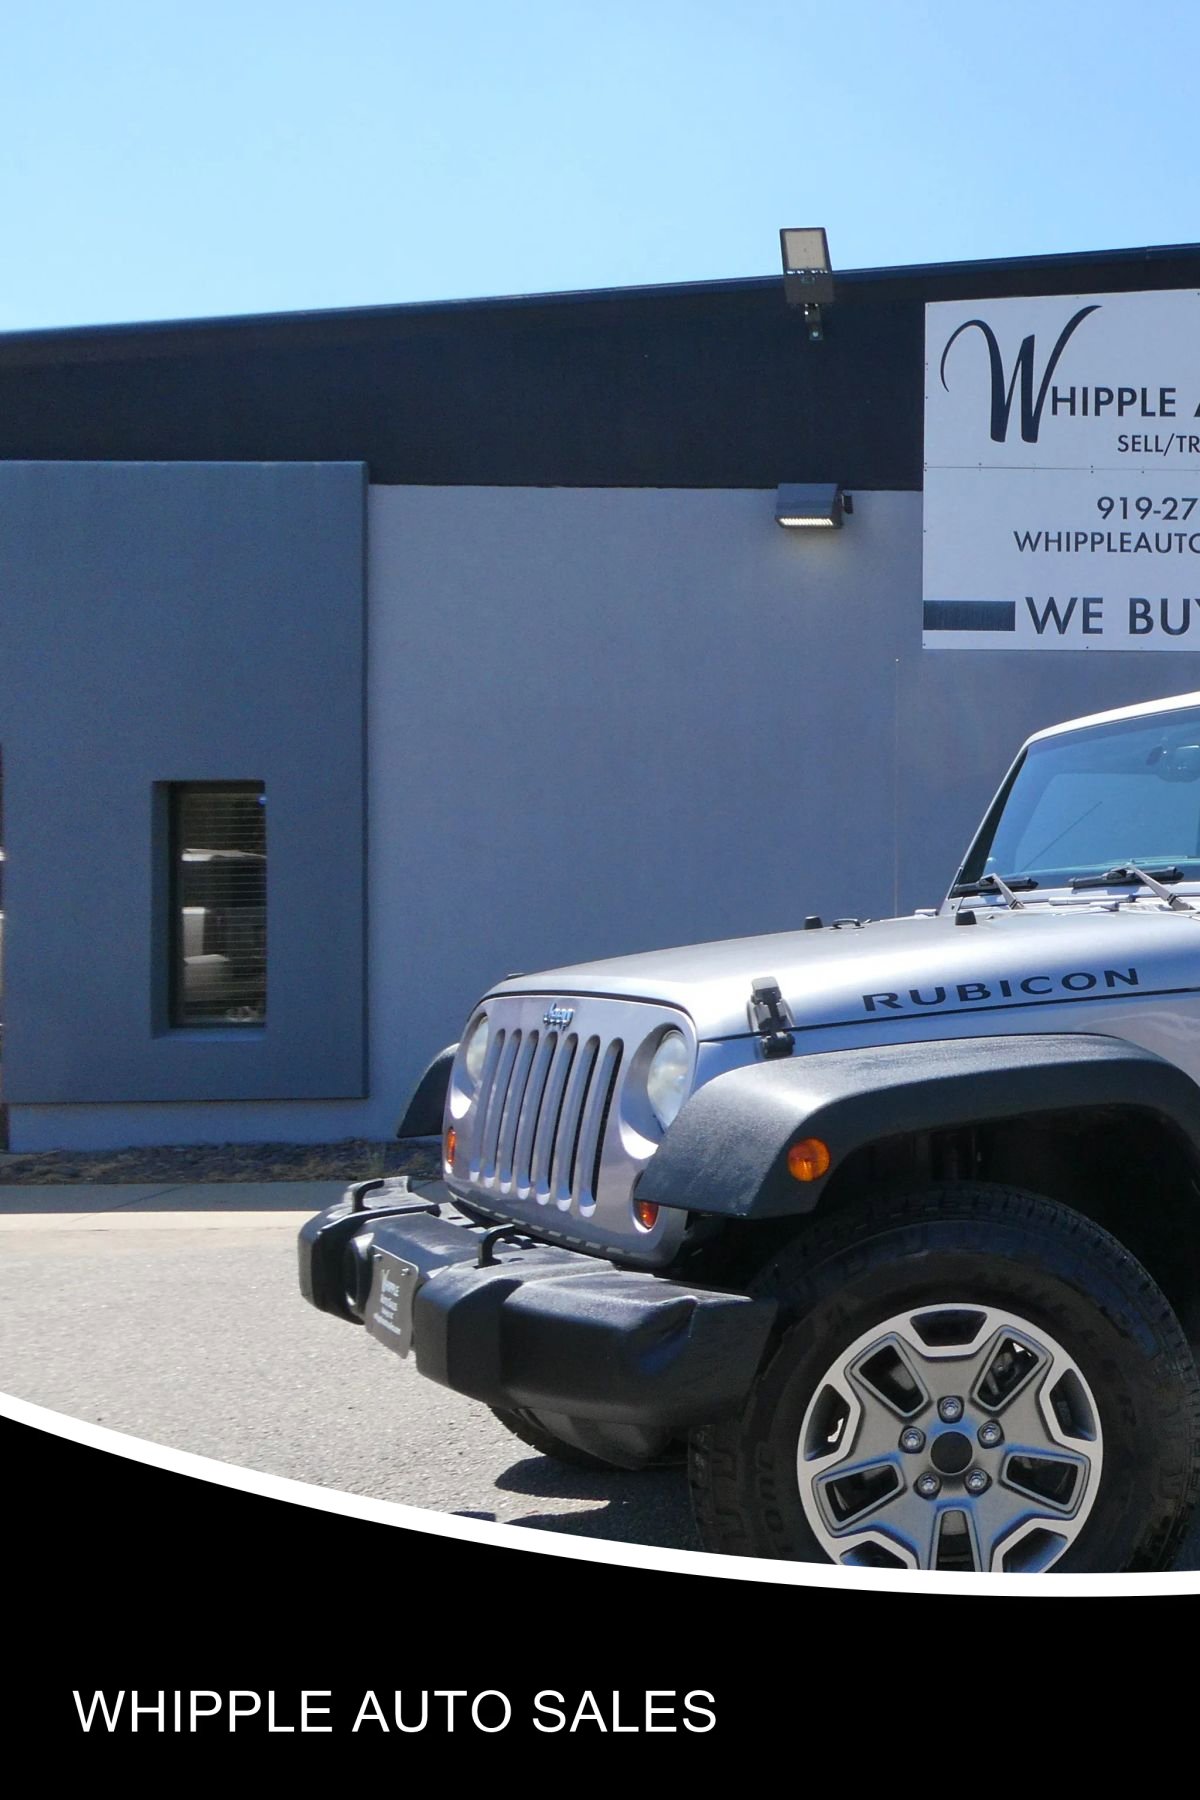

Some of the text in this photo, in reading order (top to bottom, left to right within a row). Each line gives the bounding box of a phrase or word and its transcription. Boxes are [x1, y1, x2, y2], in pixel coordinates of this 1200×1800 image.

[941, 305, 1176, 443] WHIPPLE
[1025, 597, 1103, 635] WE
[862, 967, 1140, 1011] RUBICON
